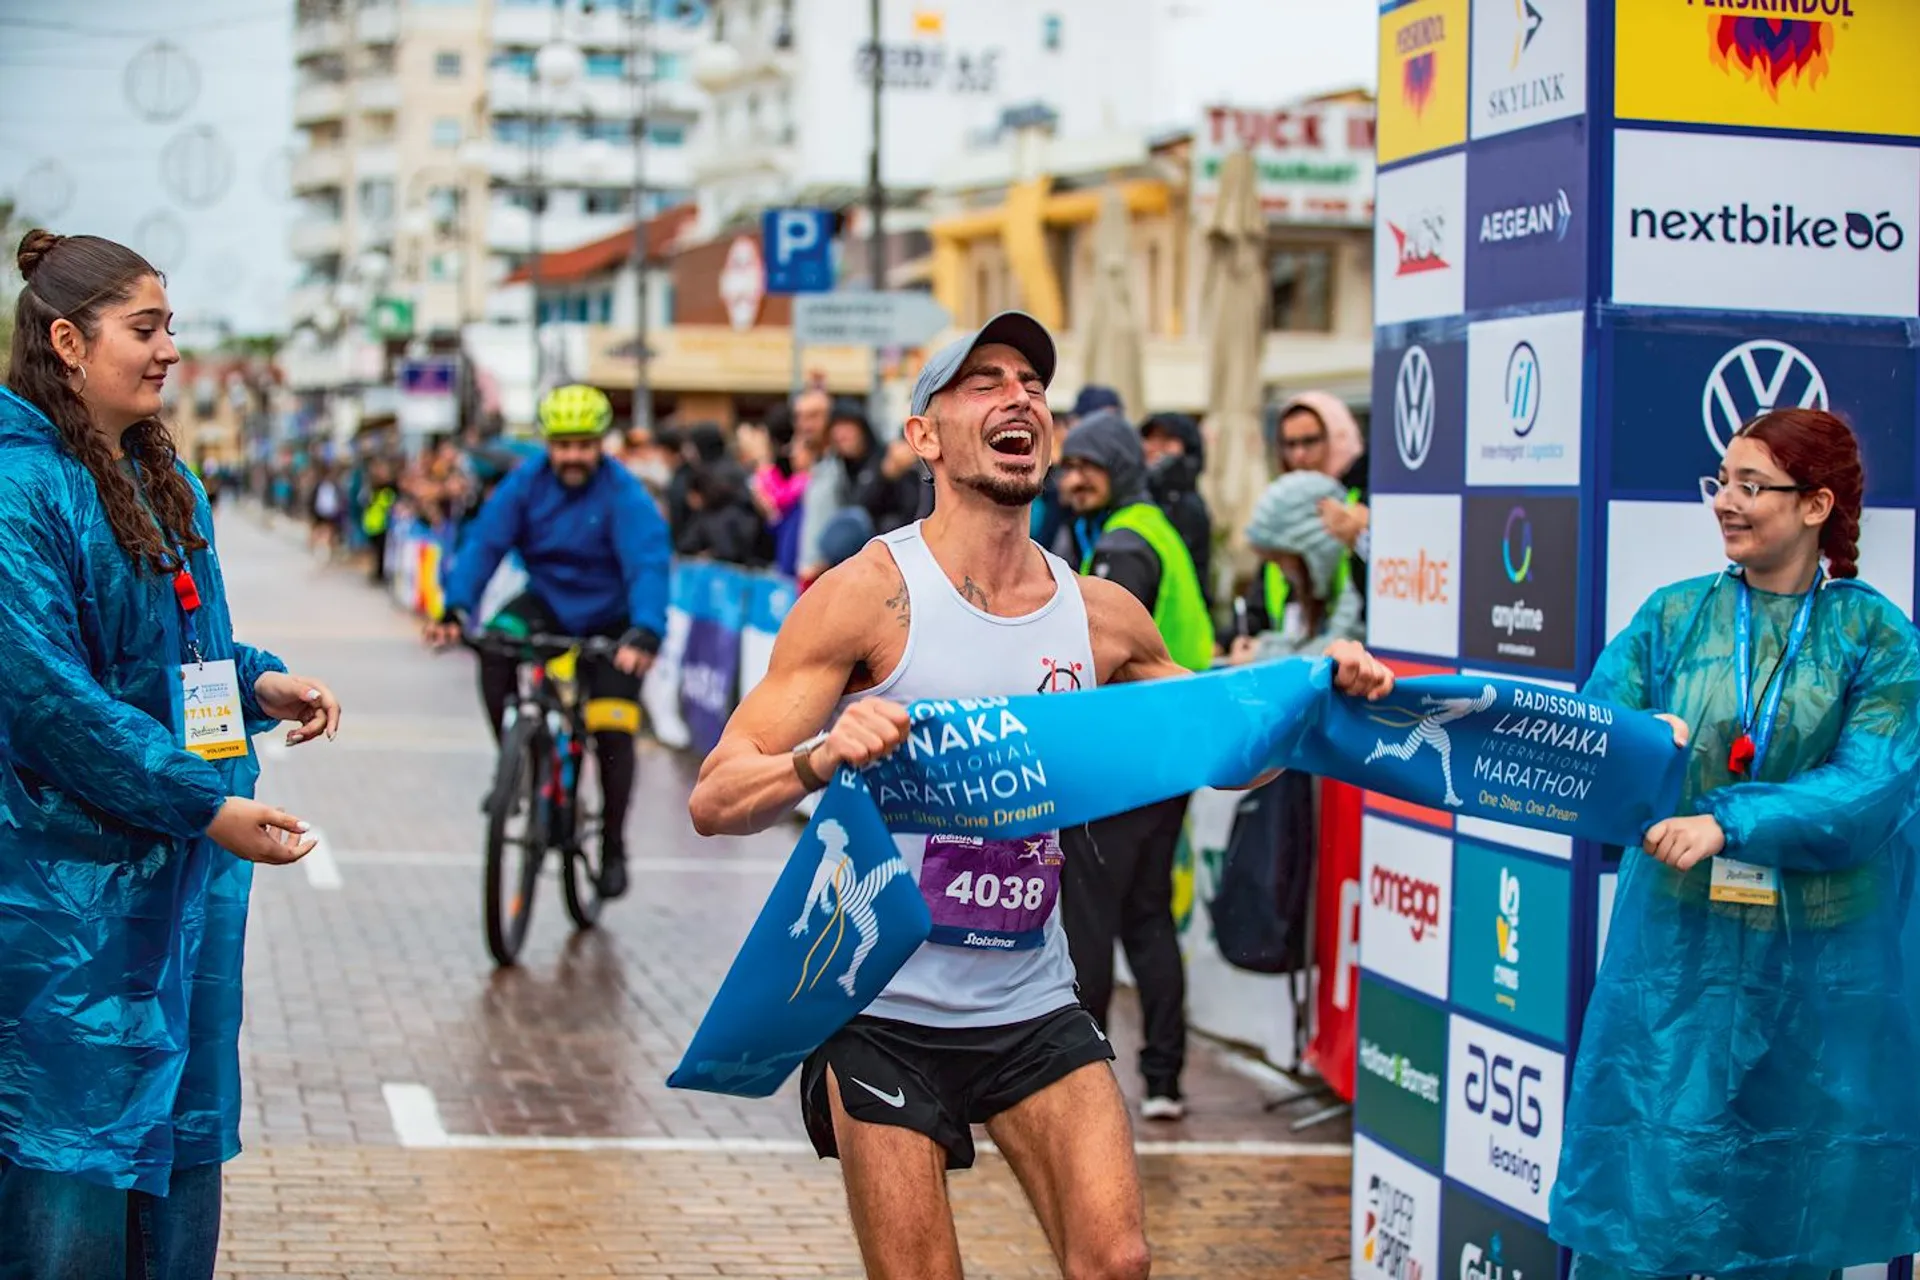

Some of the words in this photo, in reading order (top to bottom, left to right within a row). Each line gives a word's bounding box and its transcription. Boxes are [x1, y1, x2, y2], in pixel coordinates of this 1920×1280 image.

[1488, 73, 1565, 118] SKYLINK
[1208, 107, 1325, 151] TUCK
[777, 212, 820, 265] P
[1479, 202, 1554, 243] AEGEAN
[1631, 203, 1838, 249] nextbike
[1492, 600, 1543, 636] anytime
[1513, 688, 1587, 719] RADISSON
[1589, 702, 1613, 726] BLU
[1481, 737, 1598, 777] INTERNATIONAL
[1493, 712, 1609, 758] LARNAKA
[878, 760, 1048, 807] ARATHON
[1473, 755, 1592, 801] MARATHON
[953, 812, 991, 828] One
[992, 799, 1056, 826] Dream
[1478, 789, 1499, 808] One
[1525, 800, 1546, 816] One
[1546, 803, 1579, 823] Dream
[945, 870, 1046, 911] 4038
[1370, 864, 1440, 942] omega
[963, 932, 1017, 949] Stoiximar
[1488, 1133, 1541, 1195] leasing
